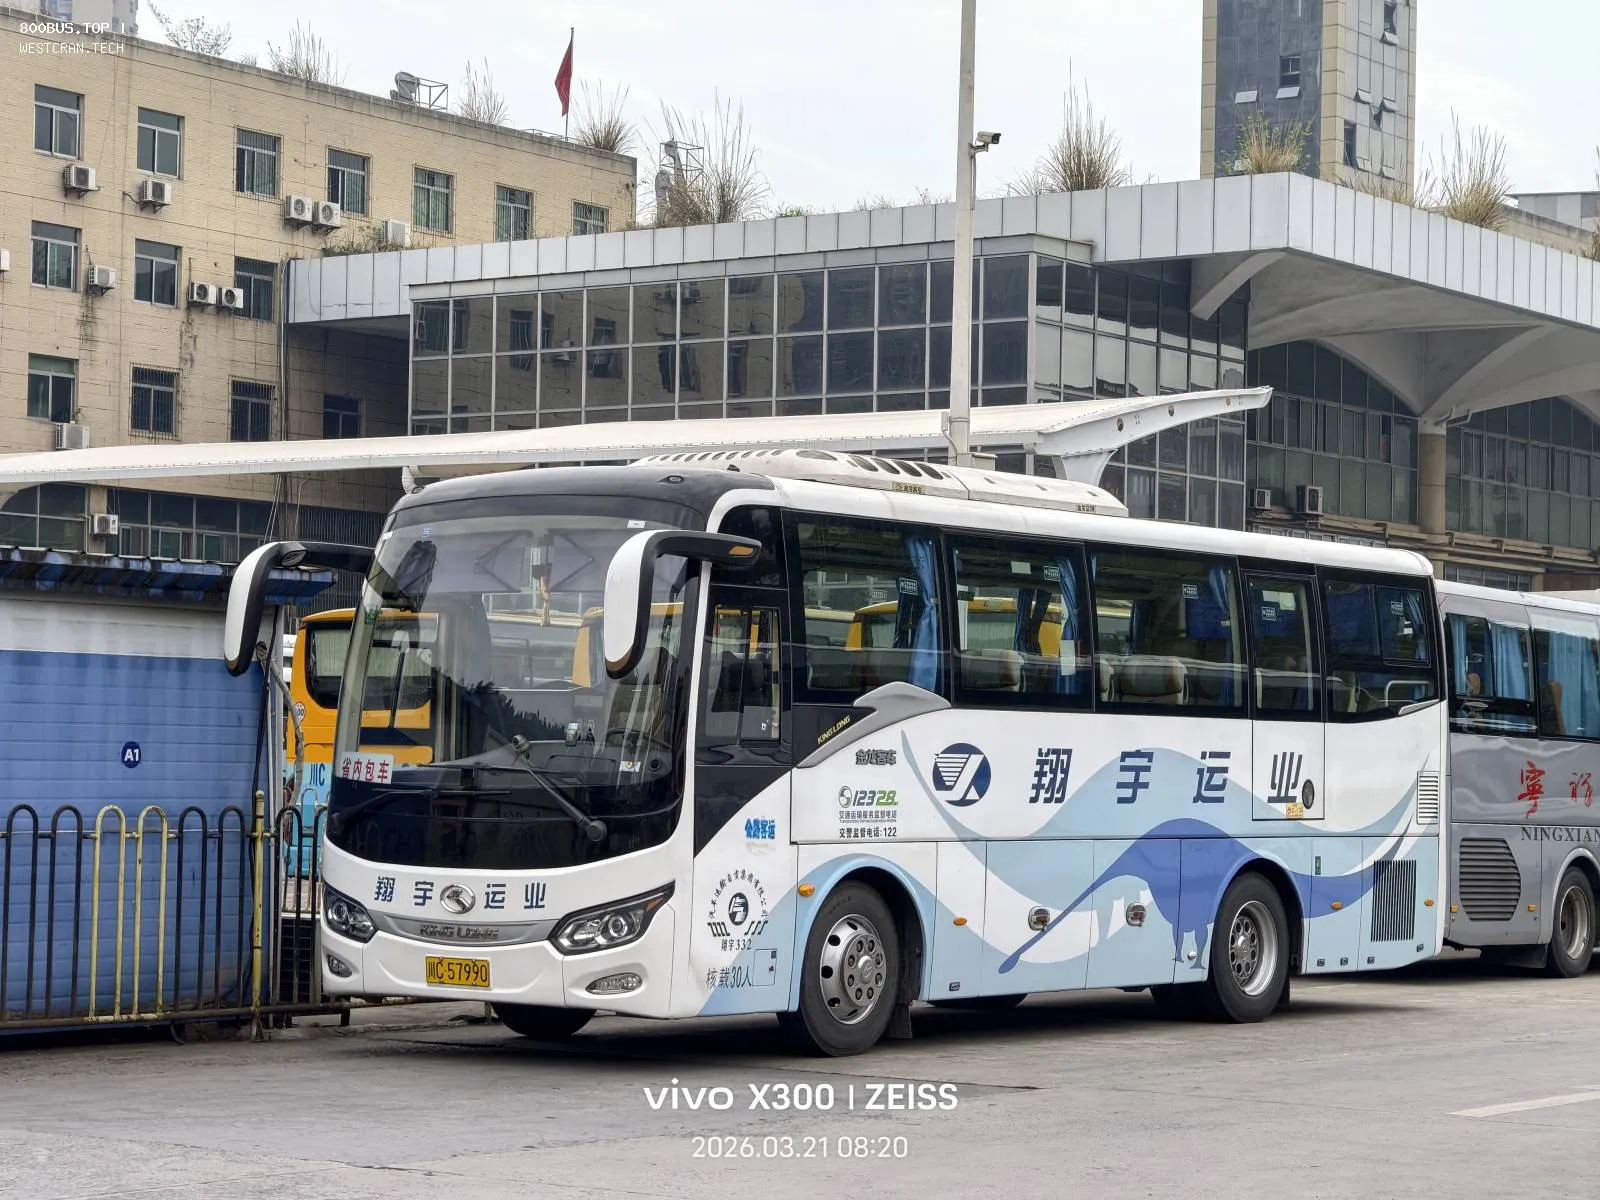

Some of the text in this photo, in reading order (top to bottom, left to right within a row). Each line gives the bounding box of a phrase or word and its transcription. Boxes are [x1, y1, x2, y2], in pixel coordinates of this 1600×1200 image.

[817, 715, 851, 744] KING LONG
[124, 748, 140, 762] A1
[342, 757, 390, 783] 省内包车
[1028, 747, 1303, 804] 翔宇运业
[852, 790, 897, 806] 12328
[721, 938, 752, 951] 翔宇332
[706, 965, 752, 990] 核载30人
